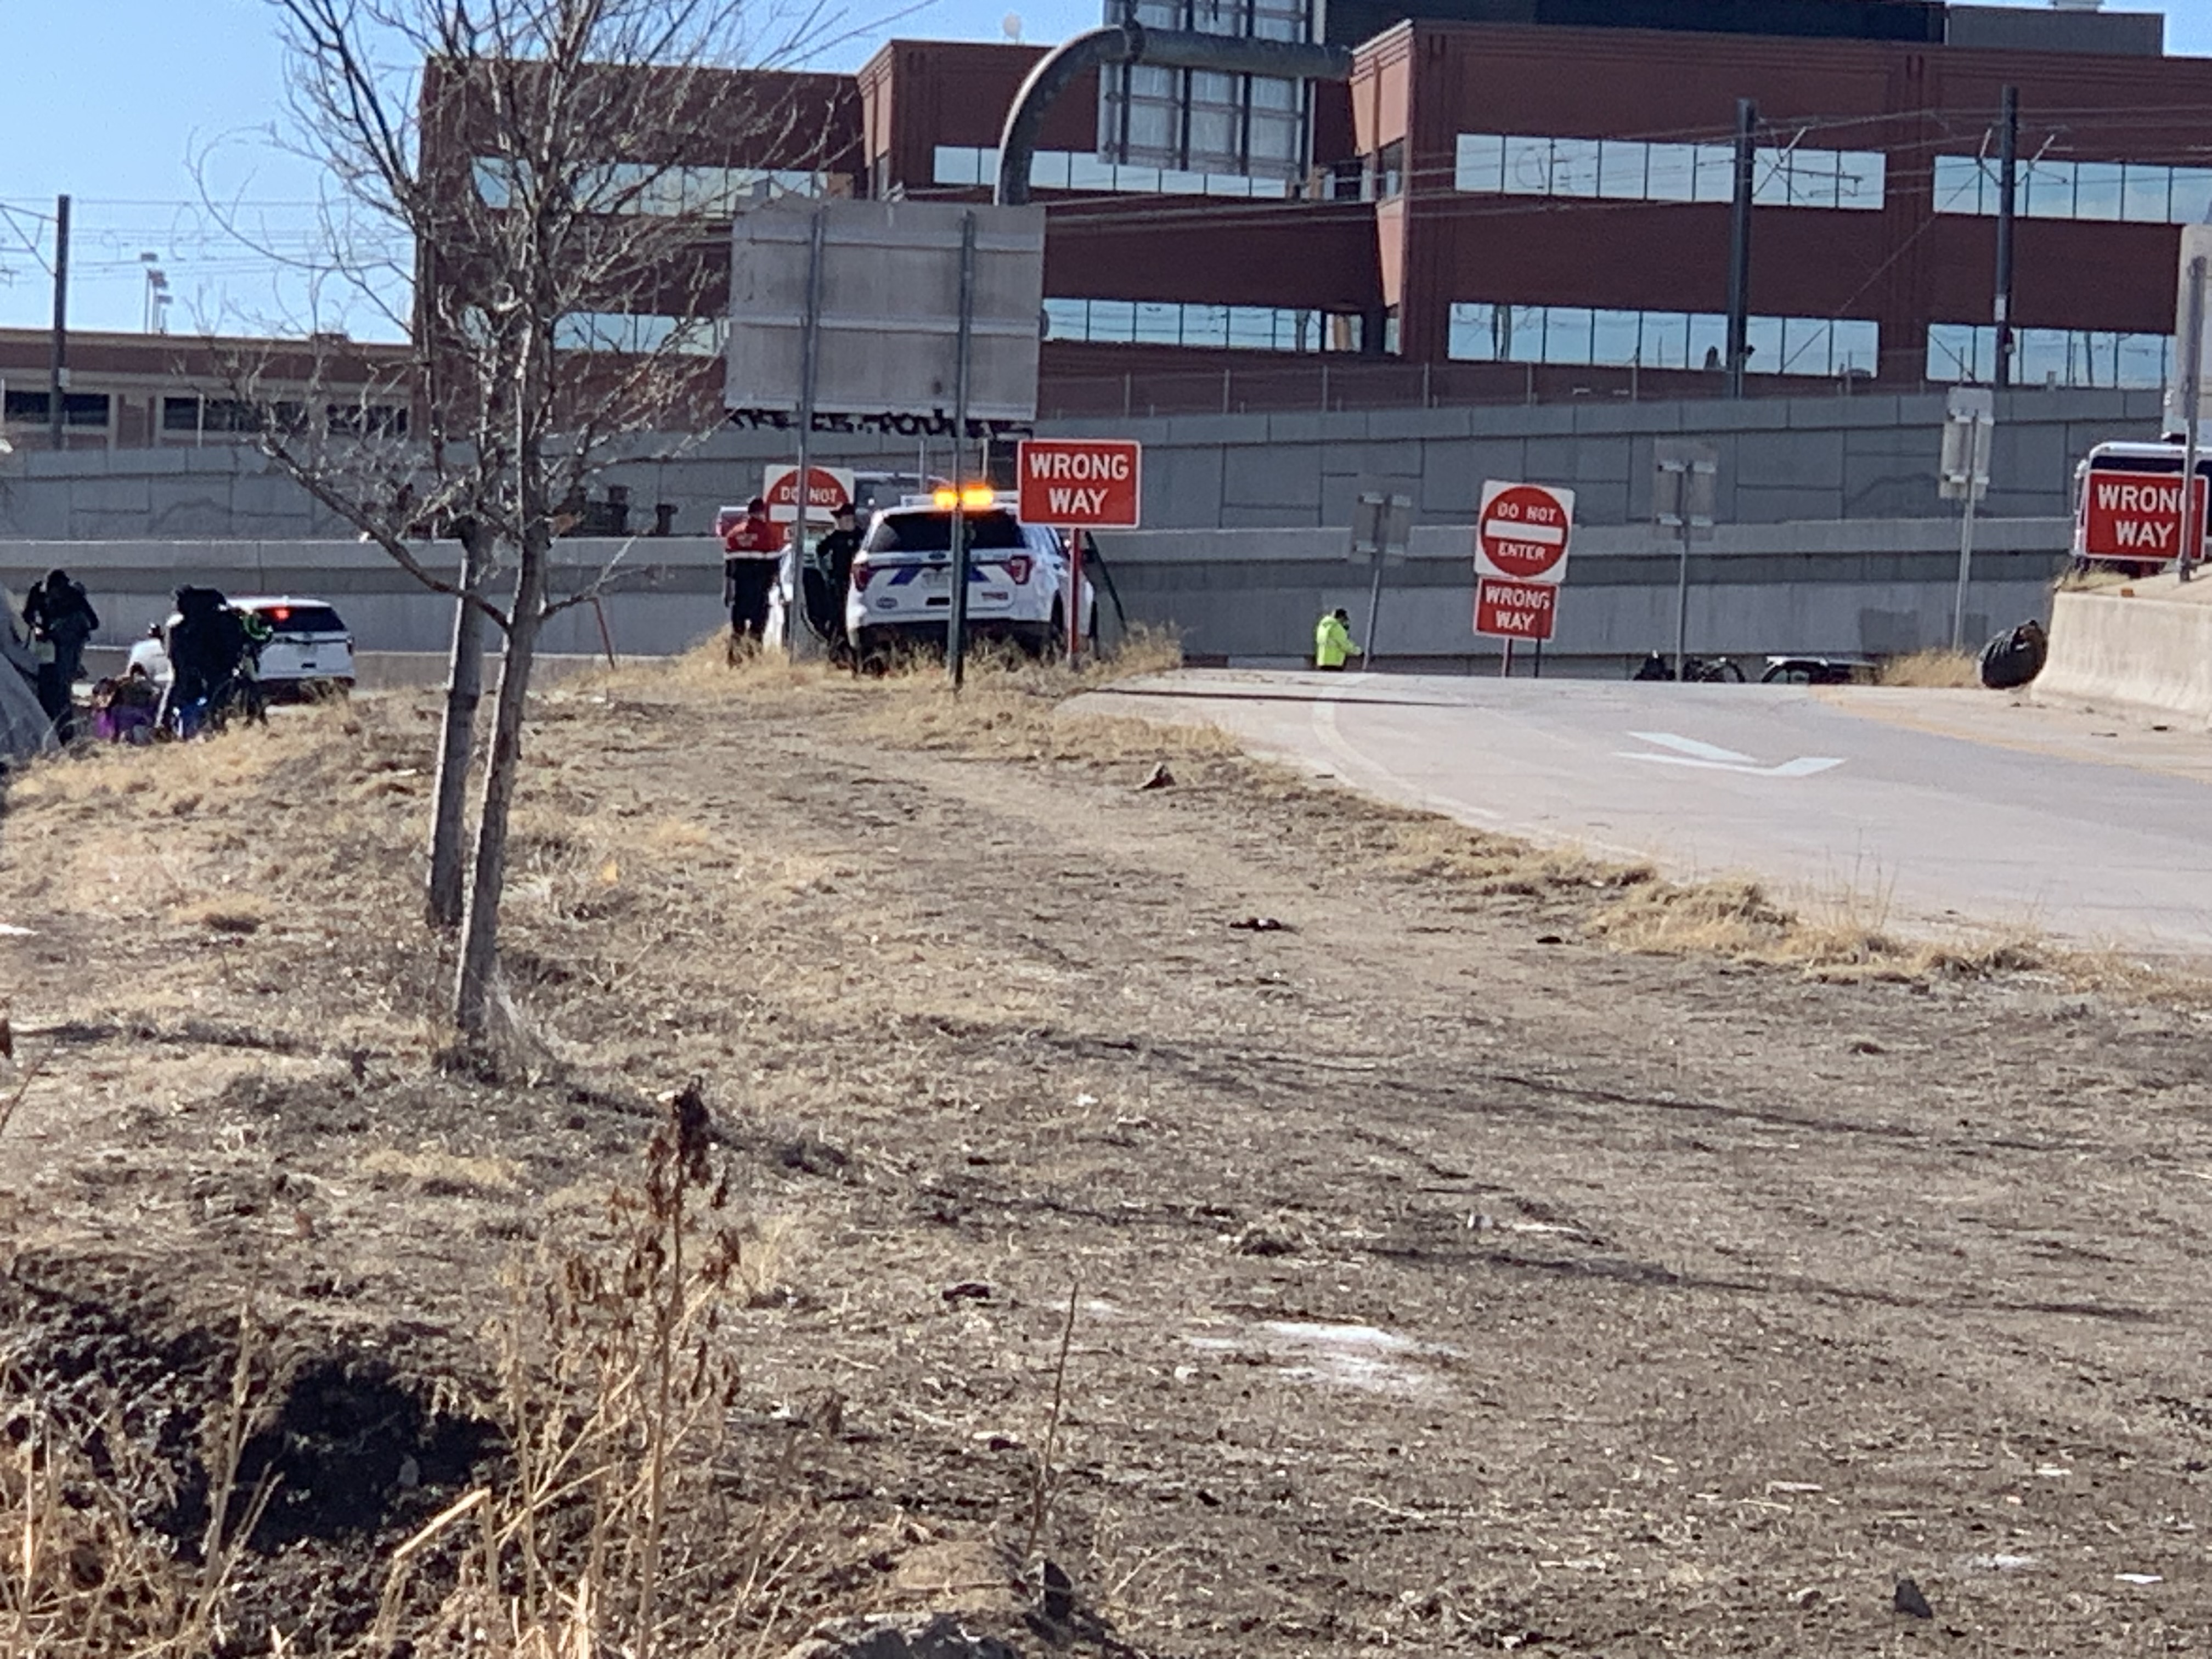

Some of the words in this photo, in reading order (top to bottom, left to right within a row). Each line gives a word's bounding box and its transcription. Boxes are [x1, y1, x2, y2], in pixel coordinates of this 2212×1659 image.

[1030, 453, 1129, 480] WRONG
[810, 487, 837, 503] NOT
[1049, 488, 1109, 515] WAY
[1497, 501, 1519, 518] DO
[1526, 505, 1556, 522] NOT
[2115, 521, 2175, 548] WAY
[1498, 541, 1546, 560] ENTER
[1486, 586, 1550, 610] WRONG
[1496, 610, 1534, 630] WAY
